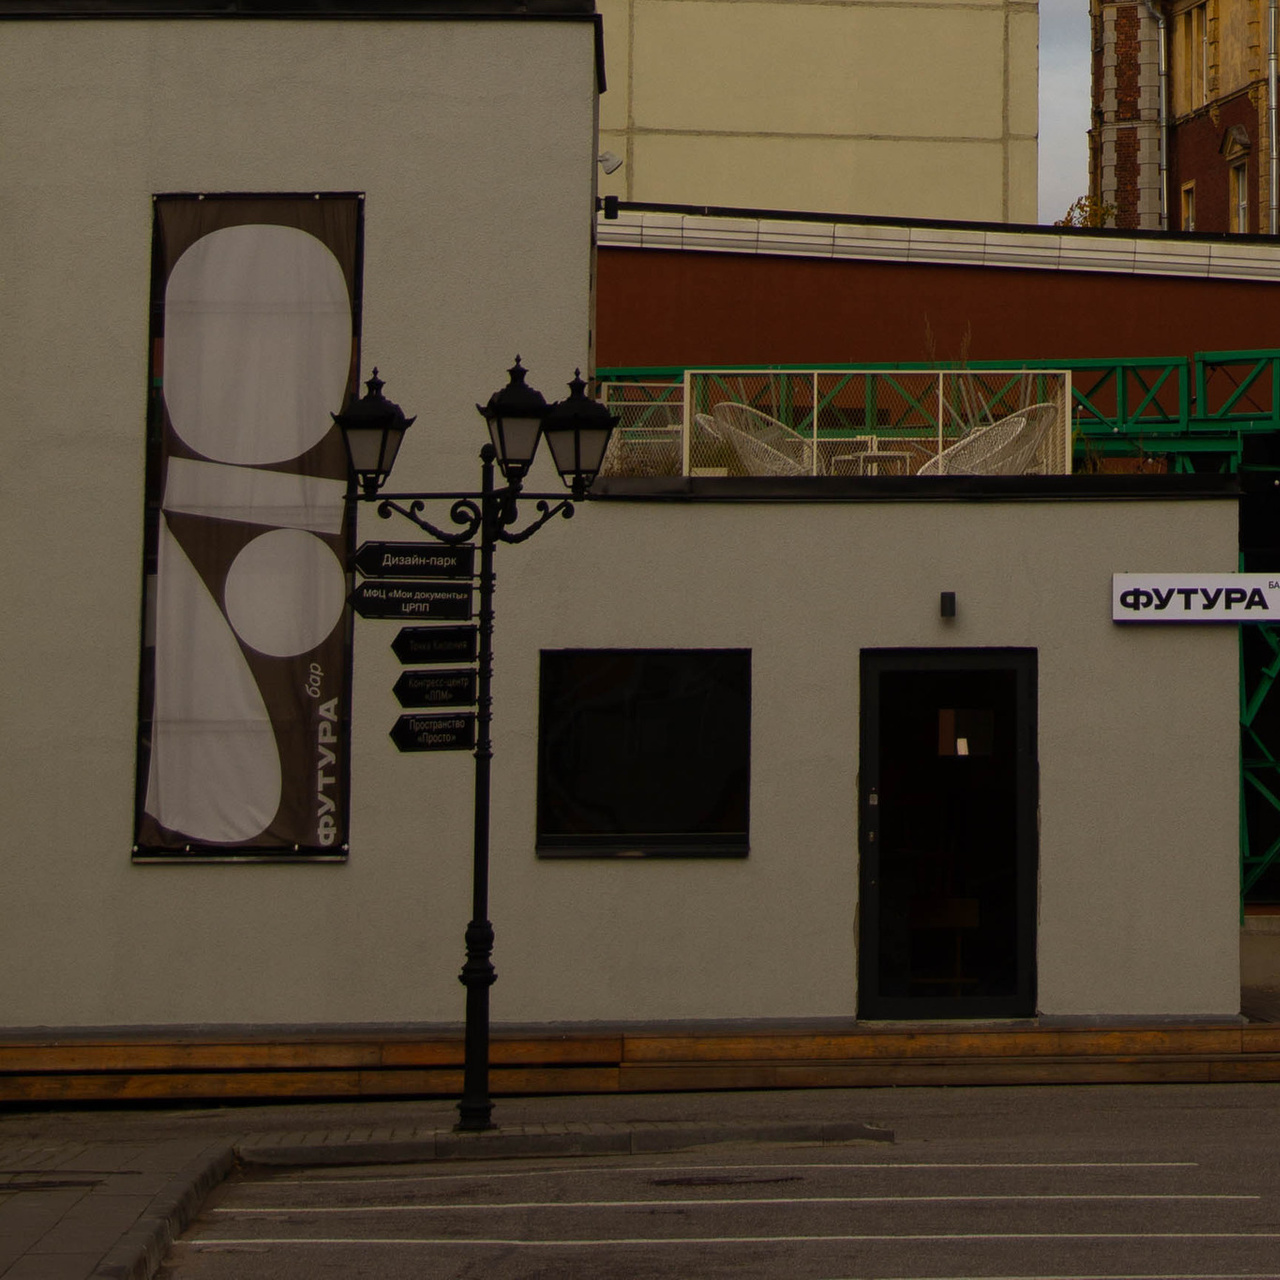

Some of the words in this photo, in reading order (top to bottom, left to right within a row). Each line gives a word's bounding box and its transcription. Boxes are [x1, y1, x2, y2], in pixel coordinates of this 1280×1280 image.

[382, 554, 457, 569] Дизайн-парк
[363, 589, 386, 600] МФЦ
[388, 589, 412, 599] «Мои
[414, 591, 468, 602] документы»
[1120, 588, 1269, 610] ФУТУРА
[402, 603, 430, 614] ЦРПП
[306, 663, 324, 698] бар
[409, 718, 466, 732] Пространство
[318, 697, 338, 845] ФУТУРА
